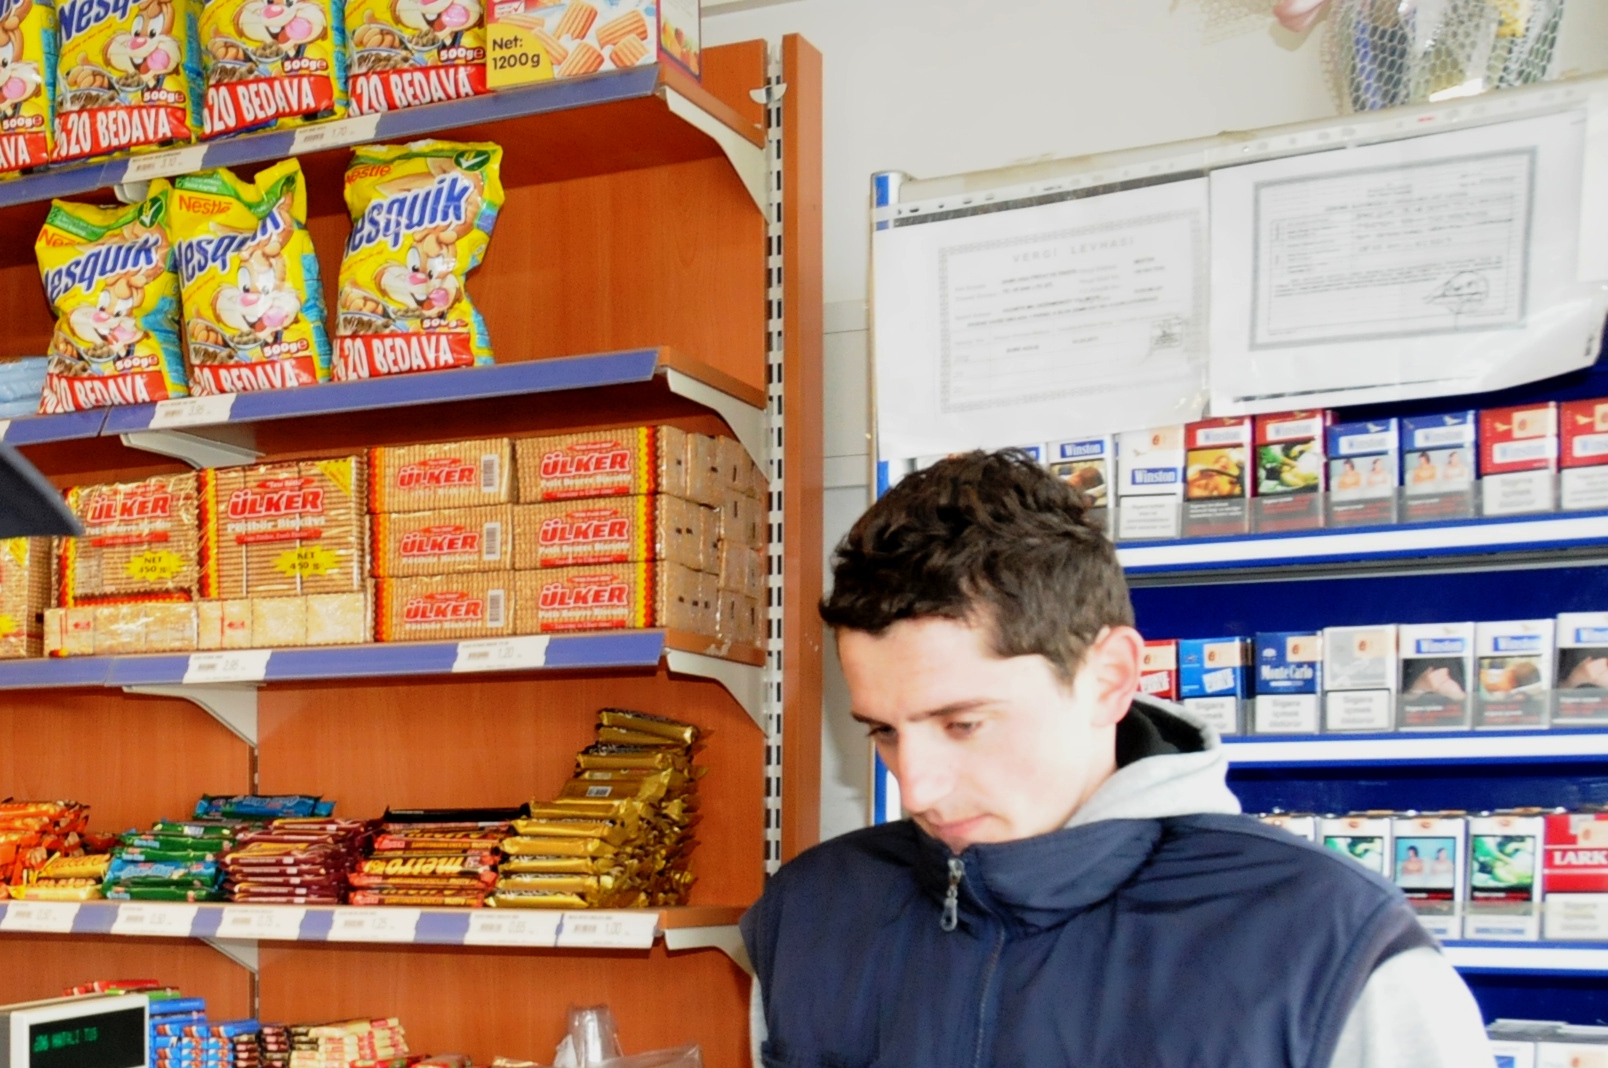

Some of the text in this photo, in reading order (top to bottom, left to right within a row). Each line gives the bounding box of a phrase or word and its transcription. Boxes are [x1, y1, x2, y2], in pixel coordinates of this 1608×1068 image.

[492, 36, 523, 51] Net:
[236, 77, 316, 122] BEDAVA
[390, 67, 475, 109] BEDAVA
[97, 108, 172, 149] BEDAVA
[372, 336, 455, 374] BEDAVA
[75, 373, 152, 409] BEDAVA
[1064, 442, 1103, 458] Winston
[398, 465, 477, 489] ÜLKER
[540, 450, 632, 479] ÜLKER
[1134, 468, 1177, 484] Winston
[86, 493, 172, 523] ÜLKER
[228, 487, 324, 519] ÜLKER
[400, 532, 480, 556] ÜLKER
[539, 518, 630, 545] ÜLKER
[143, 556, 163, 565] NET
[539, 583, 629, 609] ÜLKER
[404, 599, 483, 622] ÜLKER
[1260, 664, 1314, 680] Monte Carlo
[1553, 849, 1608, 866] LARK
